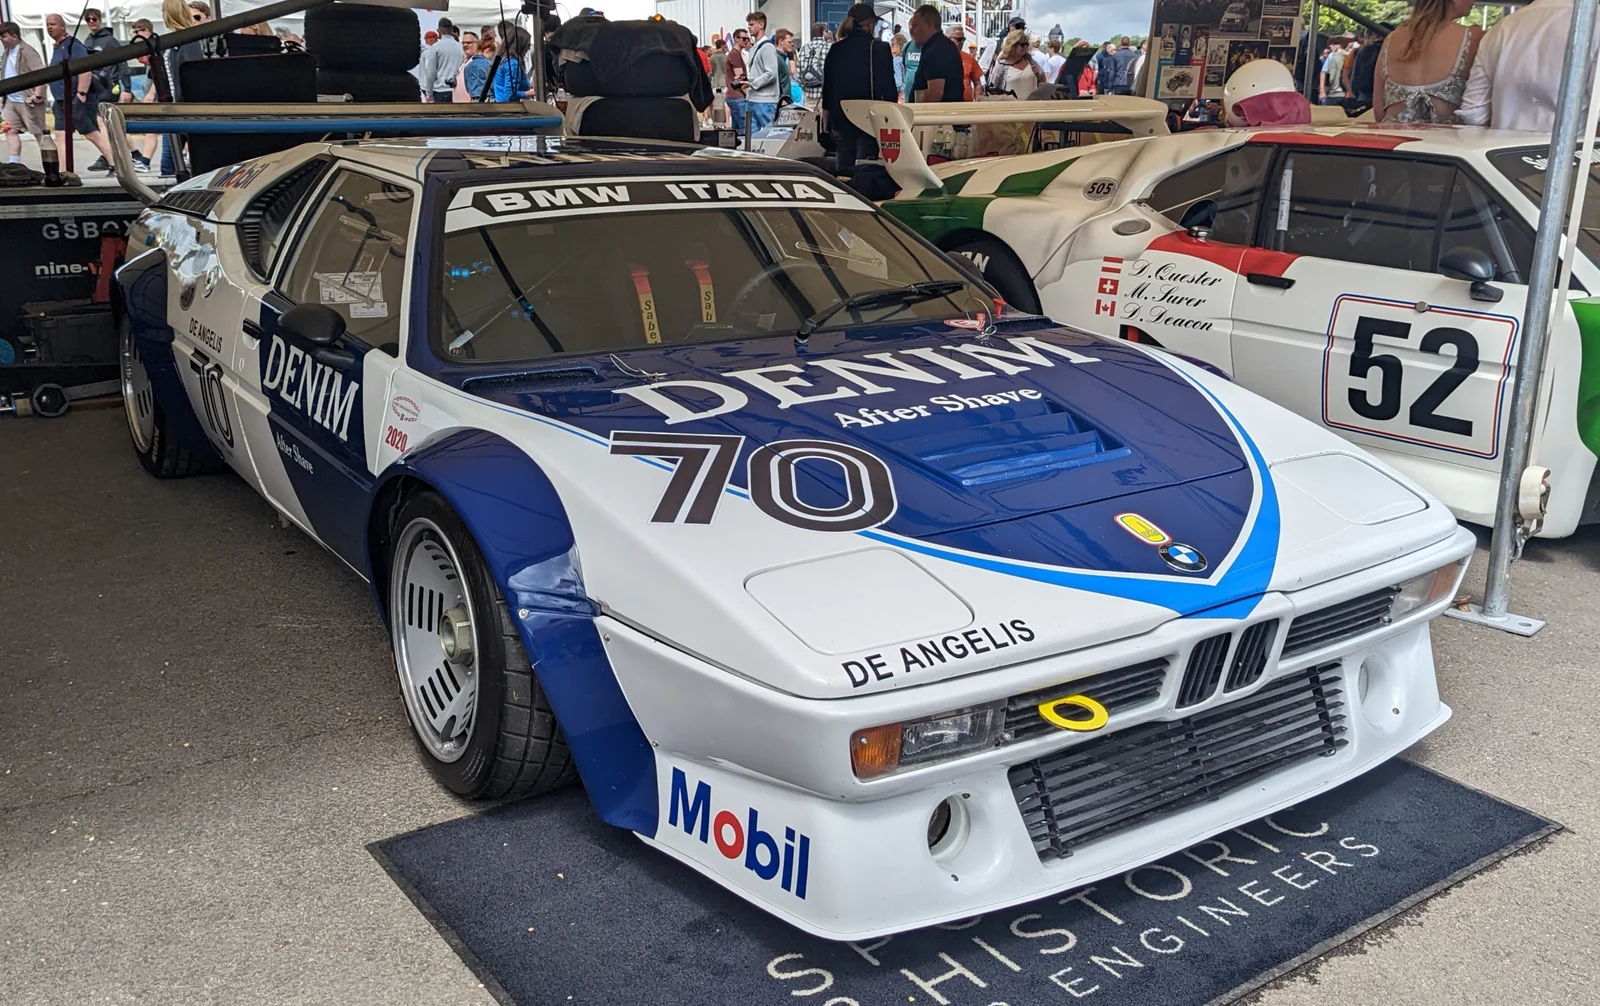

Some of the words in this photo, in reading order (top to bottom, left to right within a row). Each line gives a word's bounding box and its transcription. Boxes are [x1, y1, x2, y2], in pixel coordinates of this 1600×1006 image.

[907, 52, 922, 62] VAN
[214, 164, 270, 189] Mobil
[485, 185, 630, 213] BMW
[663, 182, 826, 200] ITALIA
[1087, 182, 1114, 195] 505
[189, 317, 198, 336] DE
[199, 323, 223, 353] ANGELIS
[644, 300, 658, 343] Sabe
[190, 346, 235, 449] 70
[262, 334, 360, 442] DENIM
[610, 336, 1102, 425] DENIM
[1348, 315, 1480, 437] 52
[834, 403, 931, 429] After
[929, 386, 1042, 413] Shave
[276, 432, 293, 458] After
[292, 443, 314, 475] Shave
[385, 424, 408, 453] 2020
[608, 429, 898, 534] 70
[841, 653, 894, 688] DE
[899, 619, 1035, 673] ANGELIS
[668, 766, 810, 900] Mobil
[900, 815, 1329, 1005] HISTORIC
[1049, 836, 1379, 998] ENGINEERS
